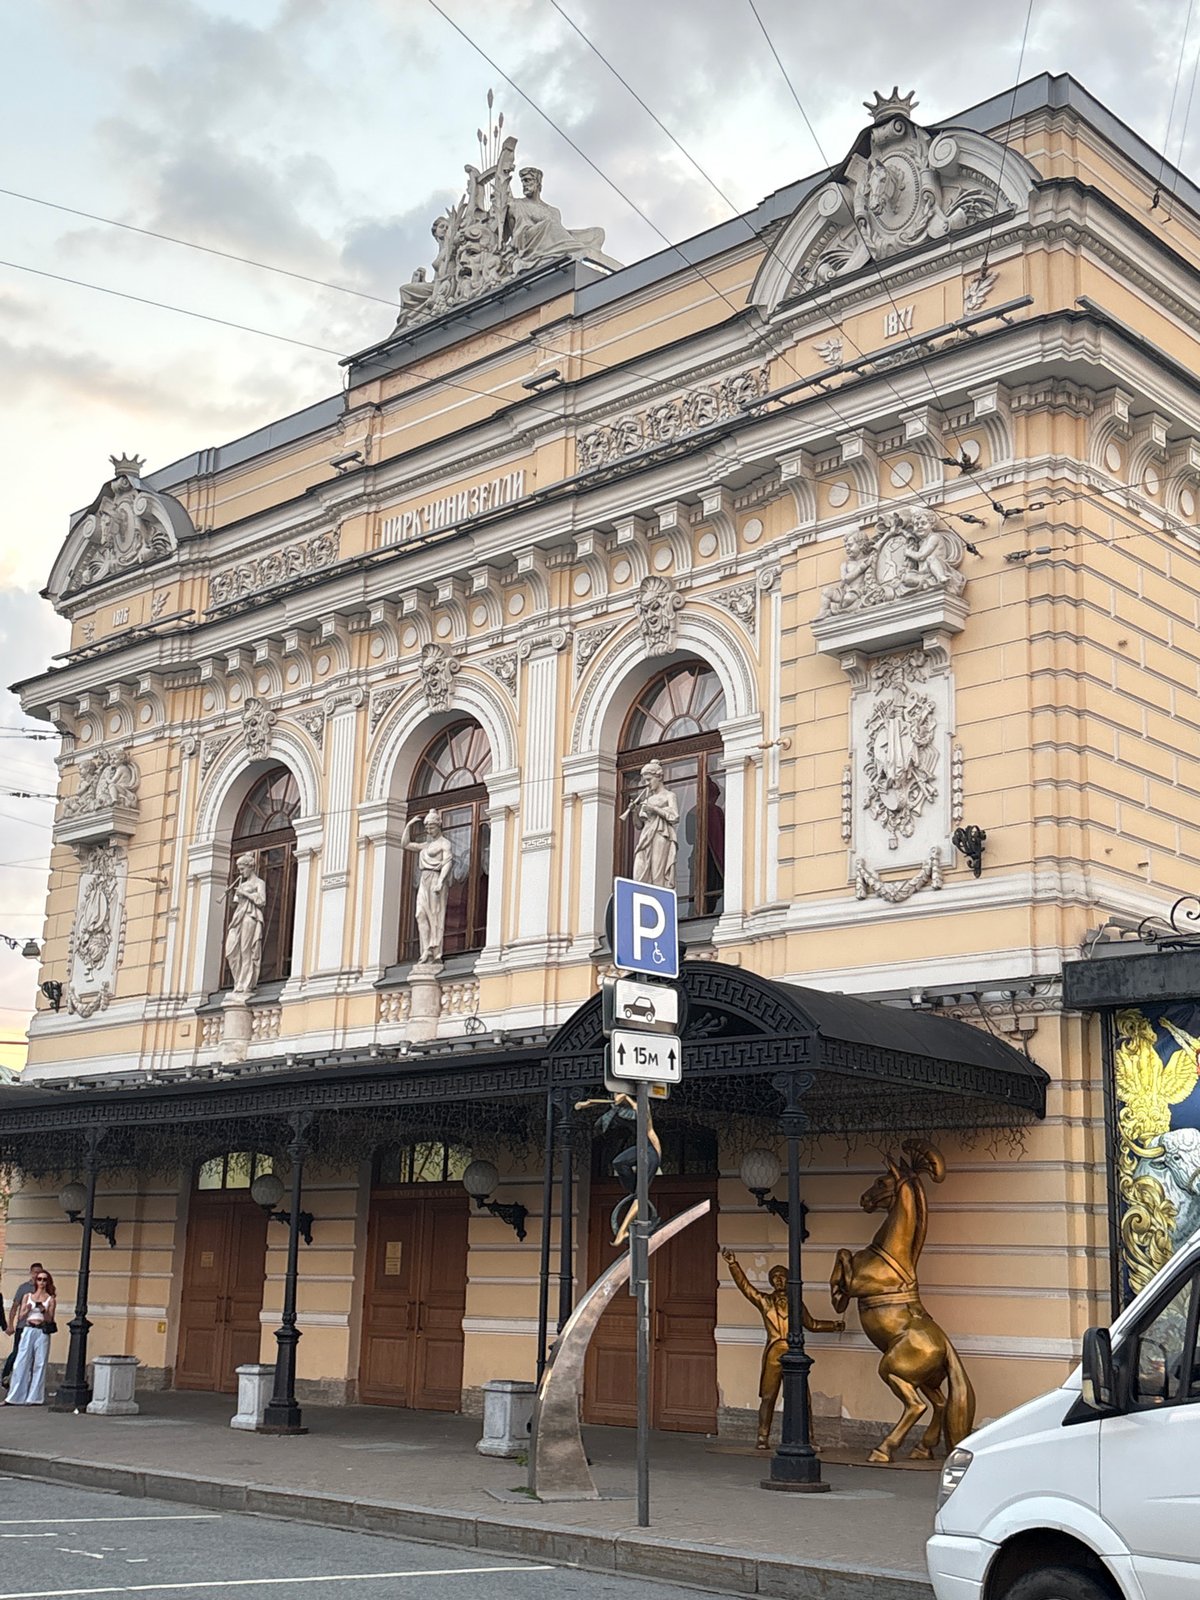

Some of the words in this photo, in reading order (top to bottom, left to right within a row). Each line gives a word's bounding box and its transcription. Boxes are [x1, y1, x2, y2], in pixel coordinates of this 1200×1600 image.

[883, 305, 915, 338] 1877
[381, 507, 423, 547] ЦИРК
[425, 469, 525, 530] ЧИНИЗЕЛЛИ
[632, 892, 665, 960] P
